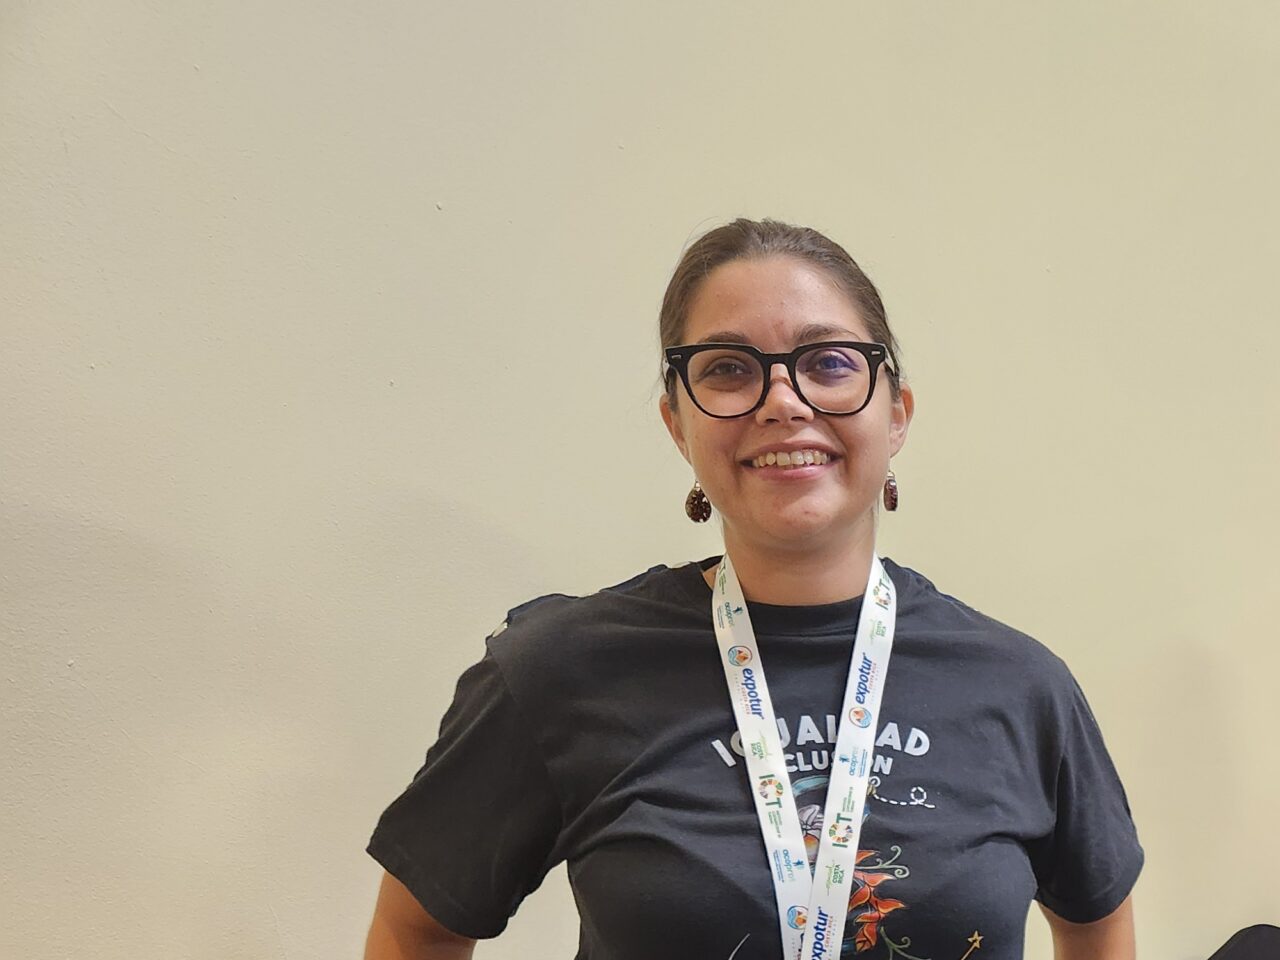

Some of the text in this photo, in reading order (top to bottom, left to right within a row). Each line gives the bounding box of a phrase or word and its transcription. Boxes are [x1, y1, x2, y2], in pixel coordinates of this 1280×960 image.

[741, 667, 763, 717] expotur
[856, 654, 872, 704] expotur
[712, 715, 930, 767] IUALAD
